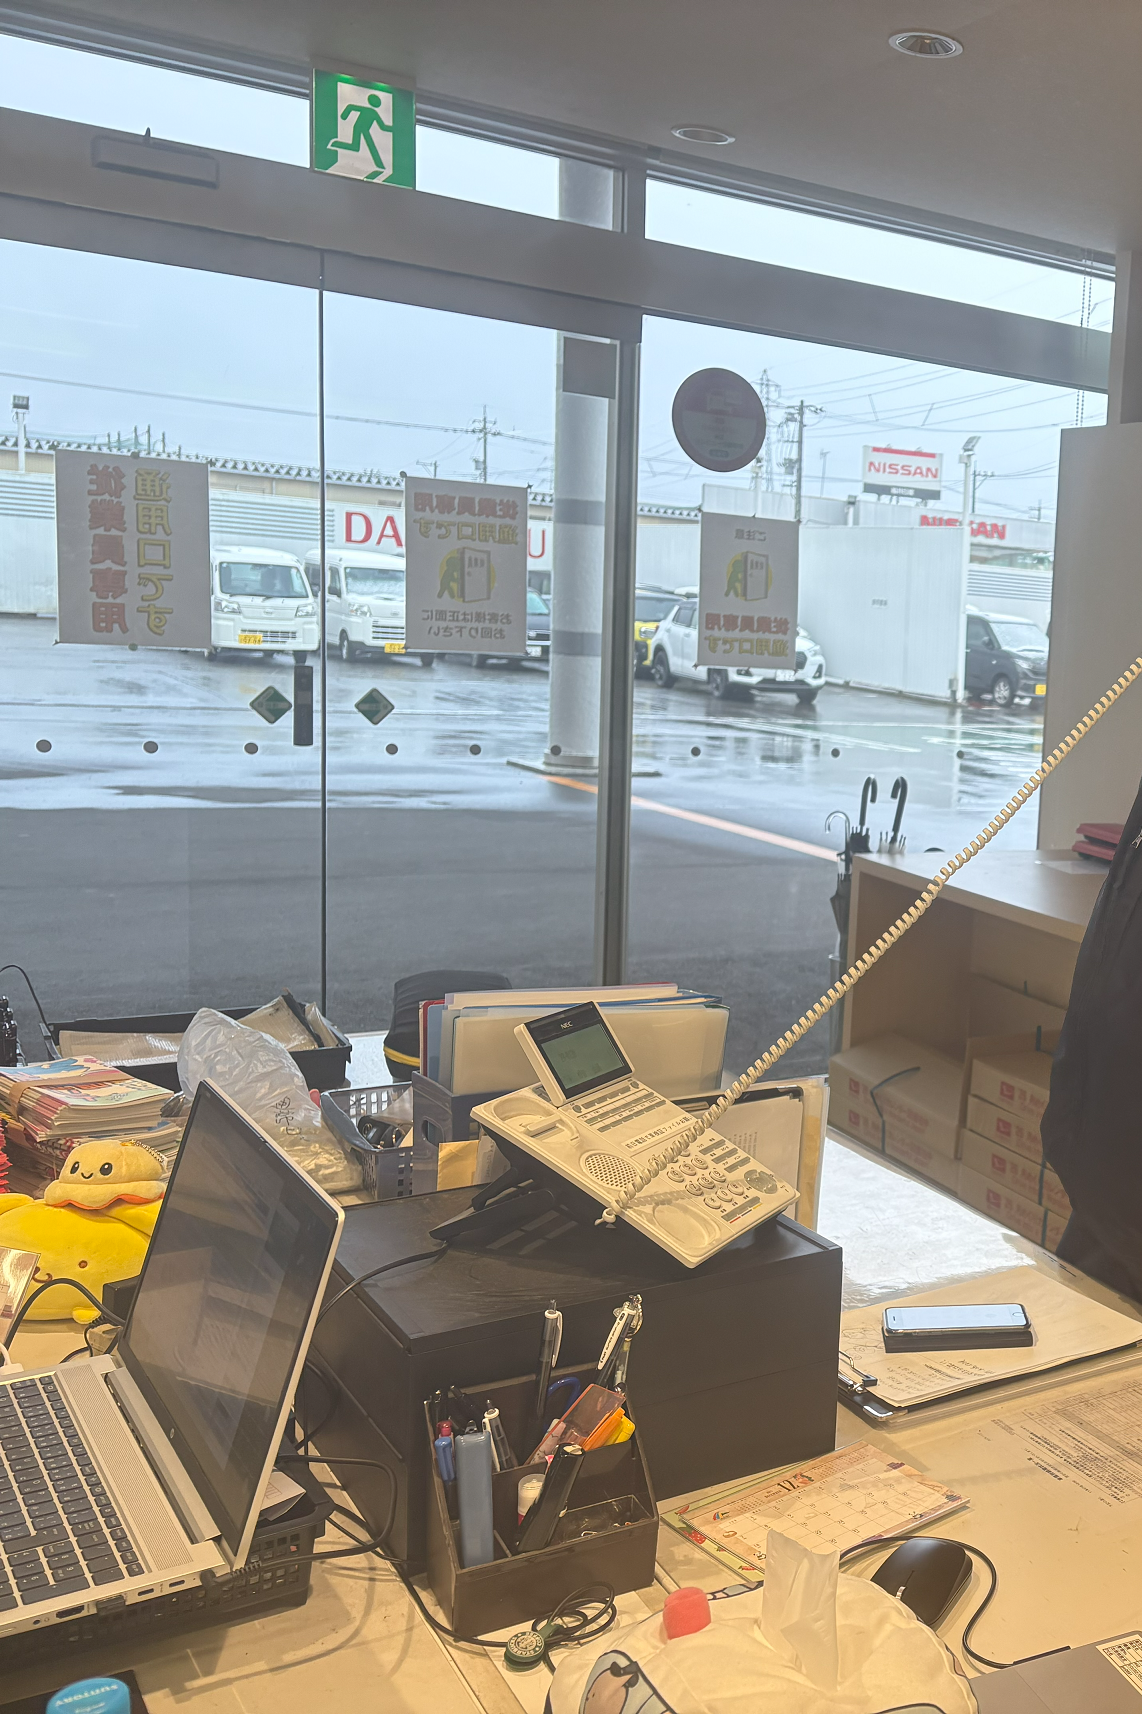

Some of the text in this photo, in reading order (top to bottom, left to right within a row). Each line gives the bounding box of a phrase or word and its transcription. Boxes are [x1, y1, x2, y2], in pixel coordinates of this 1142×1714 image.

[867, 461, 939, 479] NISSAN
[920, 515, 1007, 540] NISAN
[560, 1021, 573, 1029] NEC
[777, 1479, 799, 1492] 12
